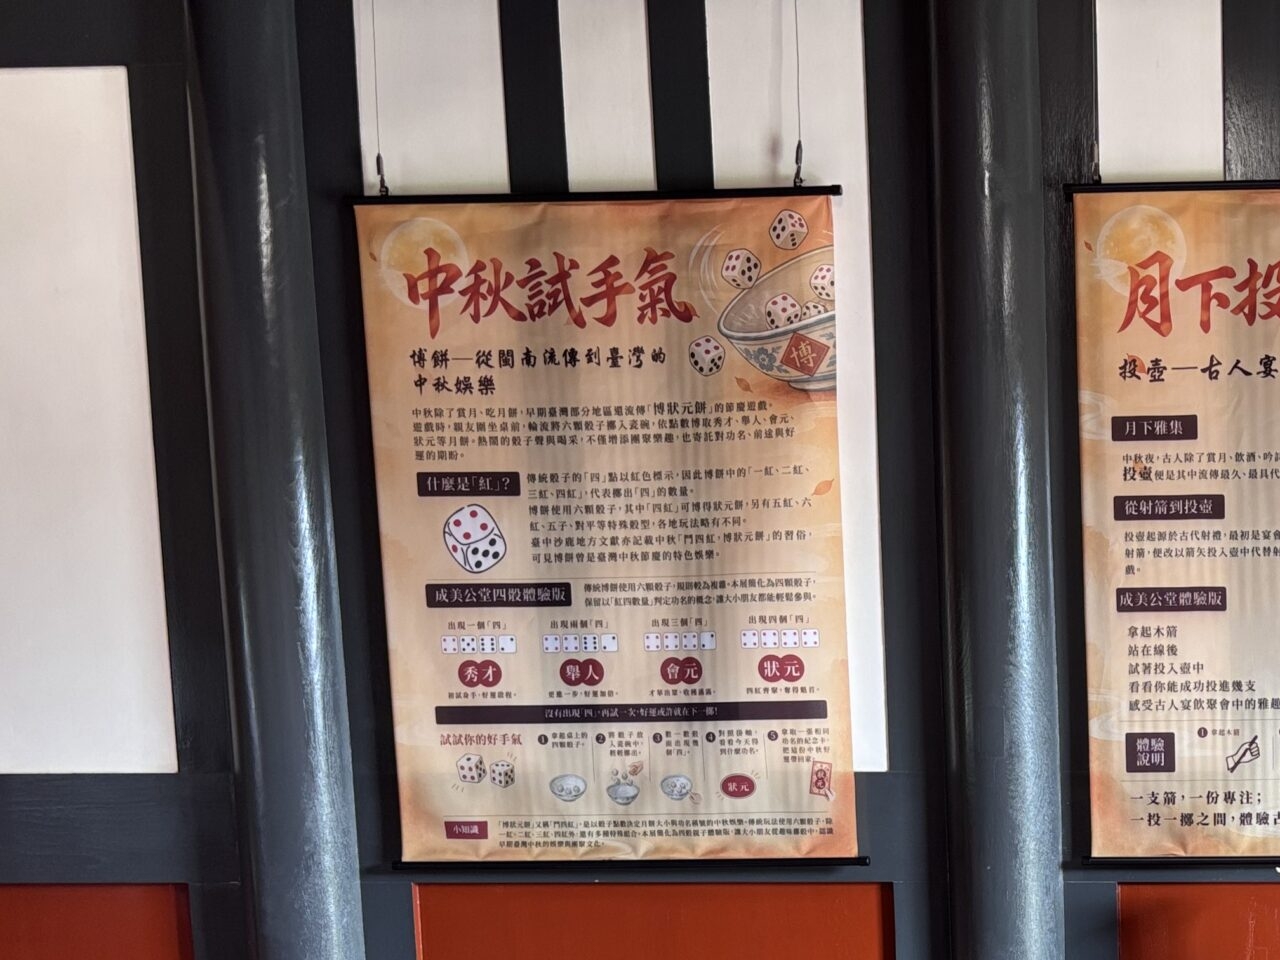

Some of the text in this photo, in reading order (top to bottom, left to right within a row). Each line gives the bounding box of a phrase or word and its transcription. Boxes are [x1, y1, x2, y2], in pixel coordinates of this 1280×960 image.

[402, 247, 695, 339] 中秋試手氣
[790, 341, 817, 367] 博
[413, 374, 496, 395] 中秋娛樂
[1124, 420, 1183, 436] 月下雅集
[415, 450, 465, 461] 運的期盼。
[527, 465, 810, 483] 傳統骰子的「四」點以紅色標示，因此博餅中的「一紅、二紅、
[426, 475, 510, 493] 什麼是「紅」？
[528, 486, 695, 500] 三紅、四紅」，代表擲出「四」的數量。
[528, 497, 812, 516] 博餅使用六顆骰子，其中「四紅」可博得狀元餅，另有五紅、六
[1124, 499, 1213, 515] 從射箭到投壺
[532, 550, 720, 564] 可見博餅曾是臺灣中秋節慶的特色娛樂。
[1125, 565, 1141, 576] 戲。
[435, 586, 566, 603] 成美公堂四骰體驗版
[1119, 591, 1223, 607] 成美公堂體驗版
[447, 619, 507, 630] 出現一個「四」
[550, 618, 610, 629] 出現兩個「四」
[651, 616, 709, 627] 出現三個「四」
[748, 614, 810, 625] 出現四個「四」
[1128, 625, 1178, 638] 拿起木箭
[1128, 644, 1178, 657] 站在線後
[463, 666, 496, 682] 秀才
[565, 664, 600, 681] 舉人
[666, 662, 699, 679] 會元
[763, 660, 800, 678] 狀元
[1128, 661, 1204, 675] 試著投入壺中
[1129, 680, 1256, 694] 看看你能成功投進幾支
[440, 733, 523, 746] 試試你的好手氣
[1211, 728, 1240, 737] 拿起木箭
[1136, 738, 1165, 752] 體驗
[1136, 752, 1165, 767] 說明
[728, 782, 750, 792] 狀元
[1130, 790, 1263, 806] 一支箭，一份專注；
[453, 825, 480, 835] 小知識
